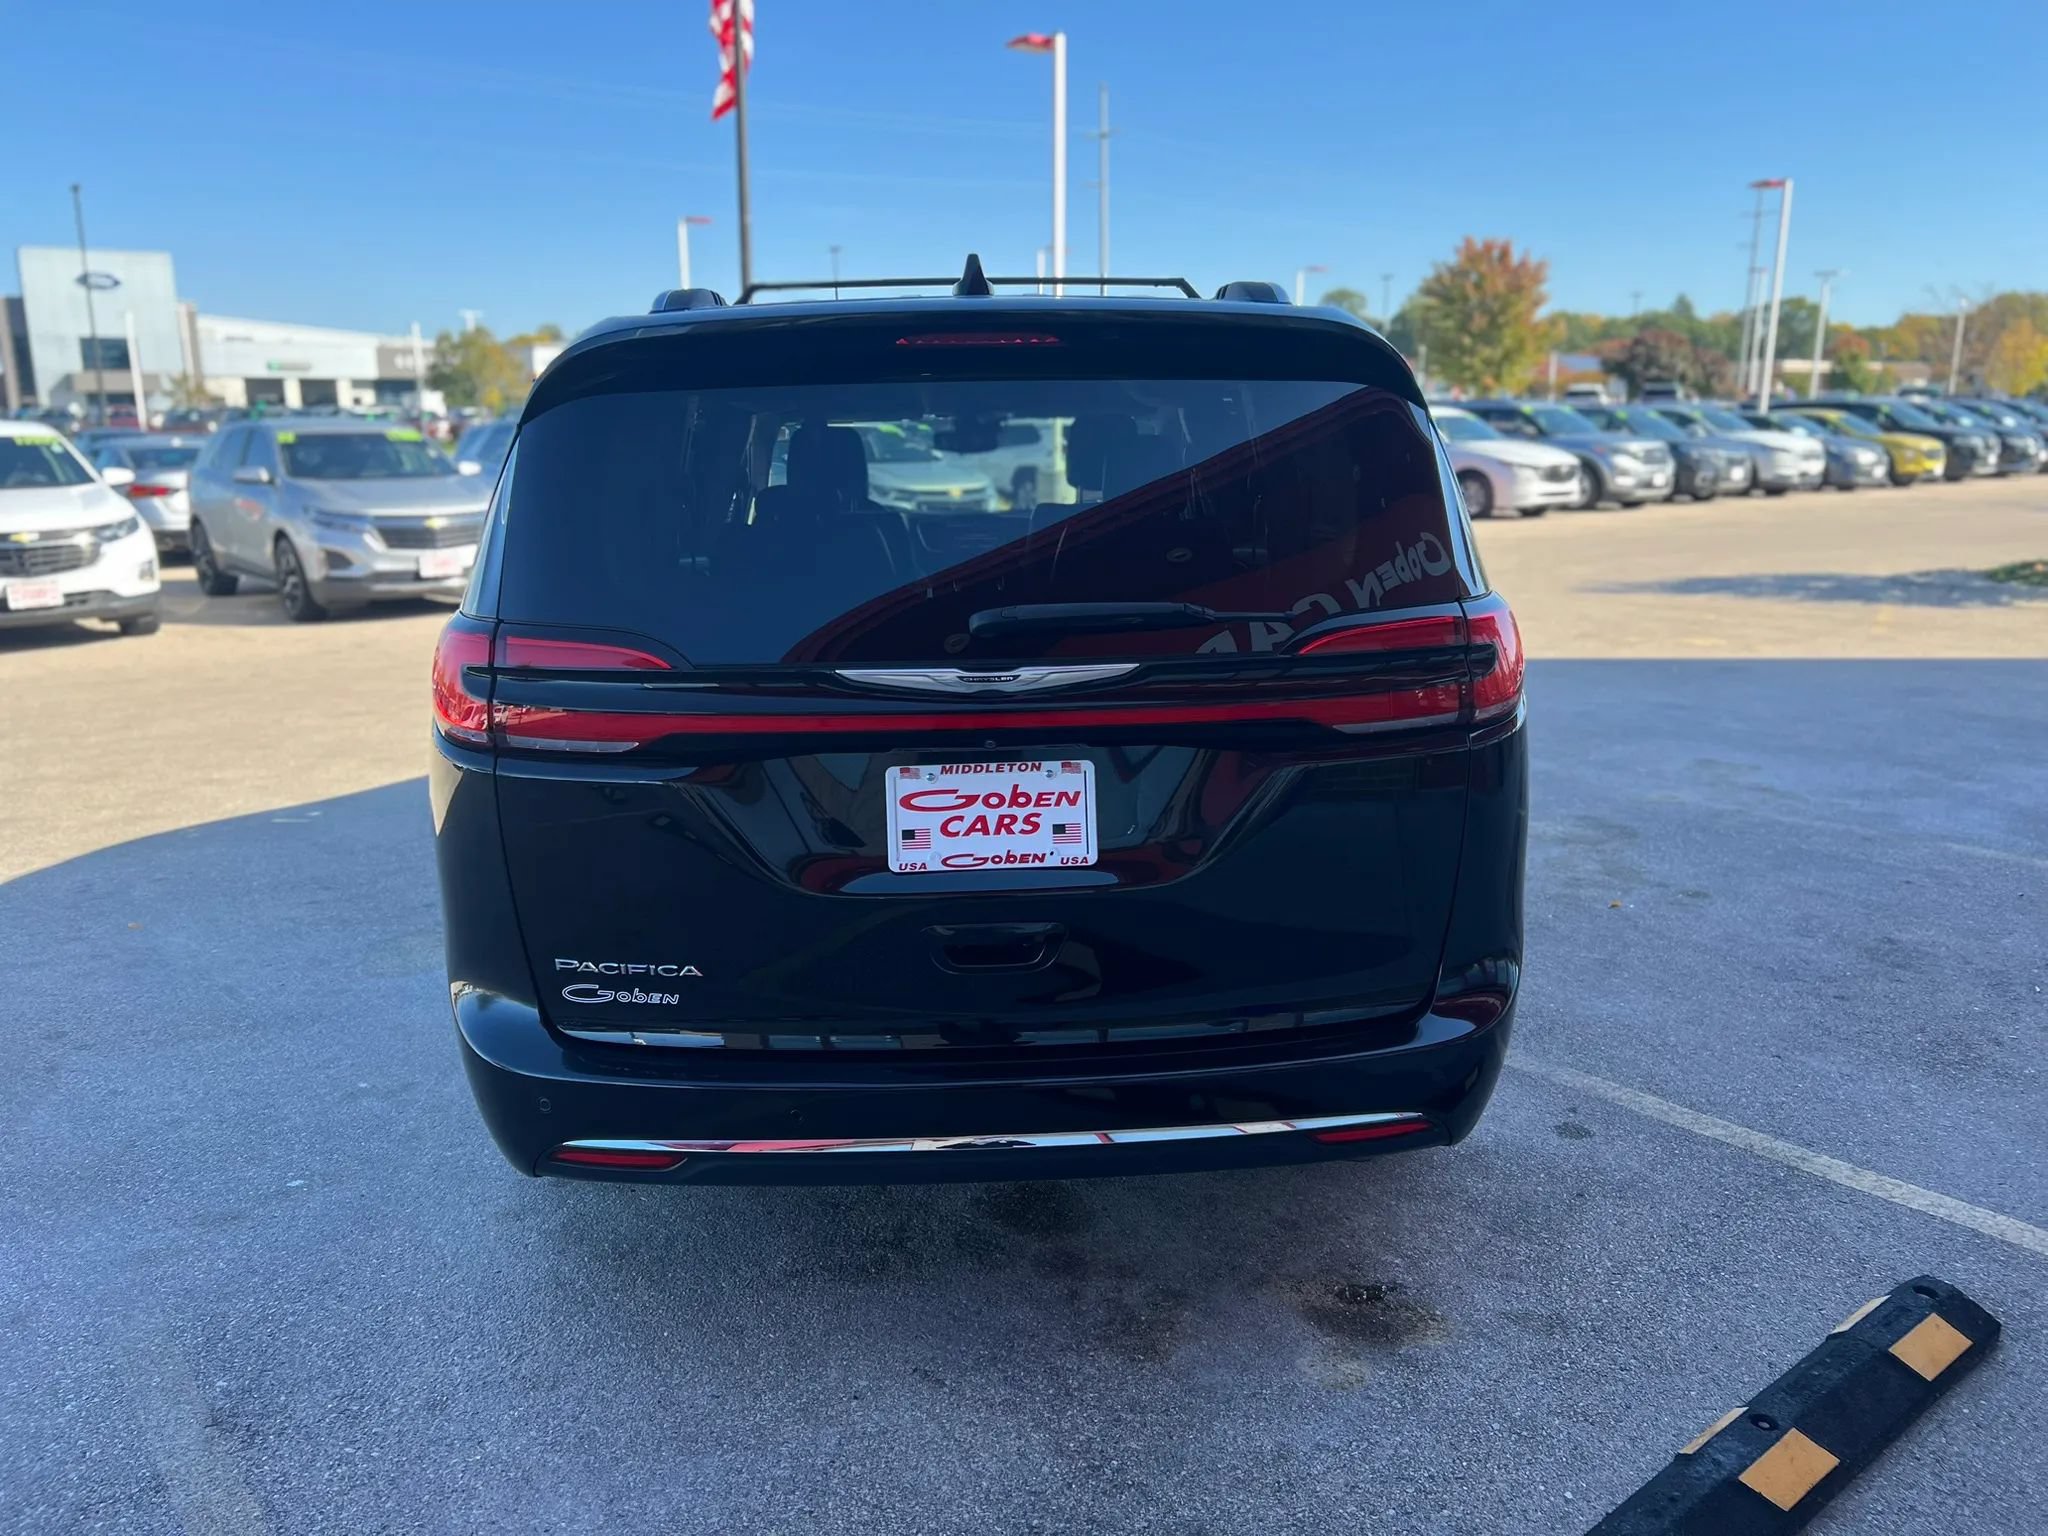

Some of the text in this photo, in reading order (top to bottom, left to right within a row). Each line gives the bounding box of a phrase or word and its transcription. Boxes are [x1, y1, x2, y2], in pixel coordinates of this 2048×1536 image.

[940, 762, 1042, 775] MIDDLETON
[940, 813, 1042, 837] CARS
[899, 862, 927, 870] USA
[1060, 856, 1089, 866] USA
[555, 959, 703, 976] PACIFICA
